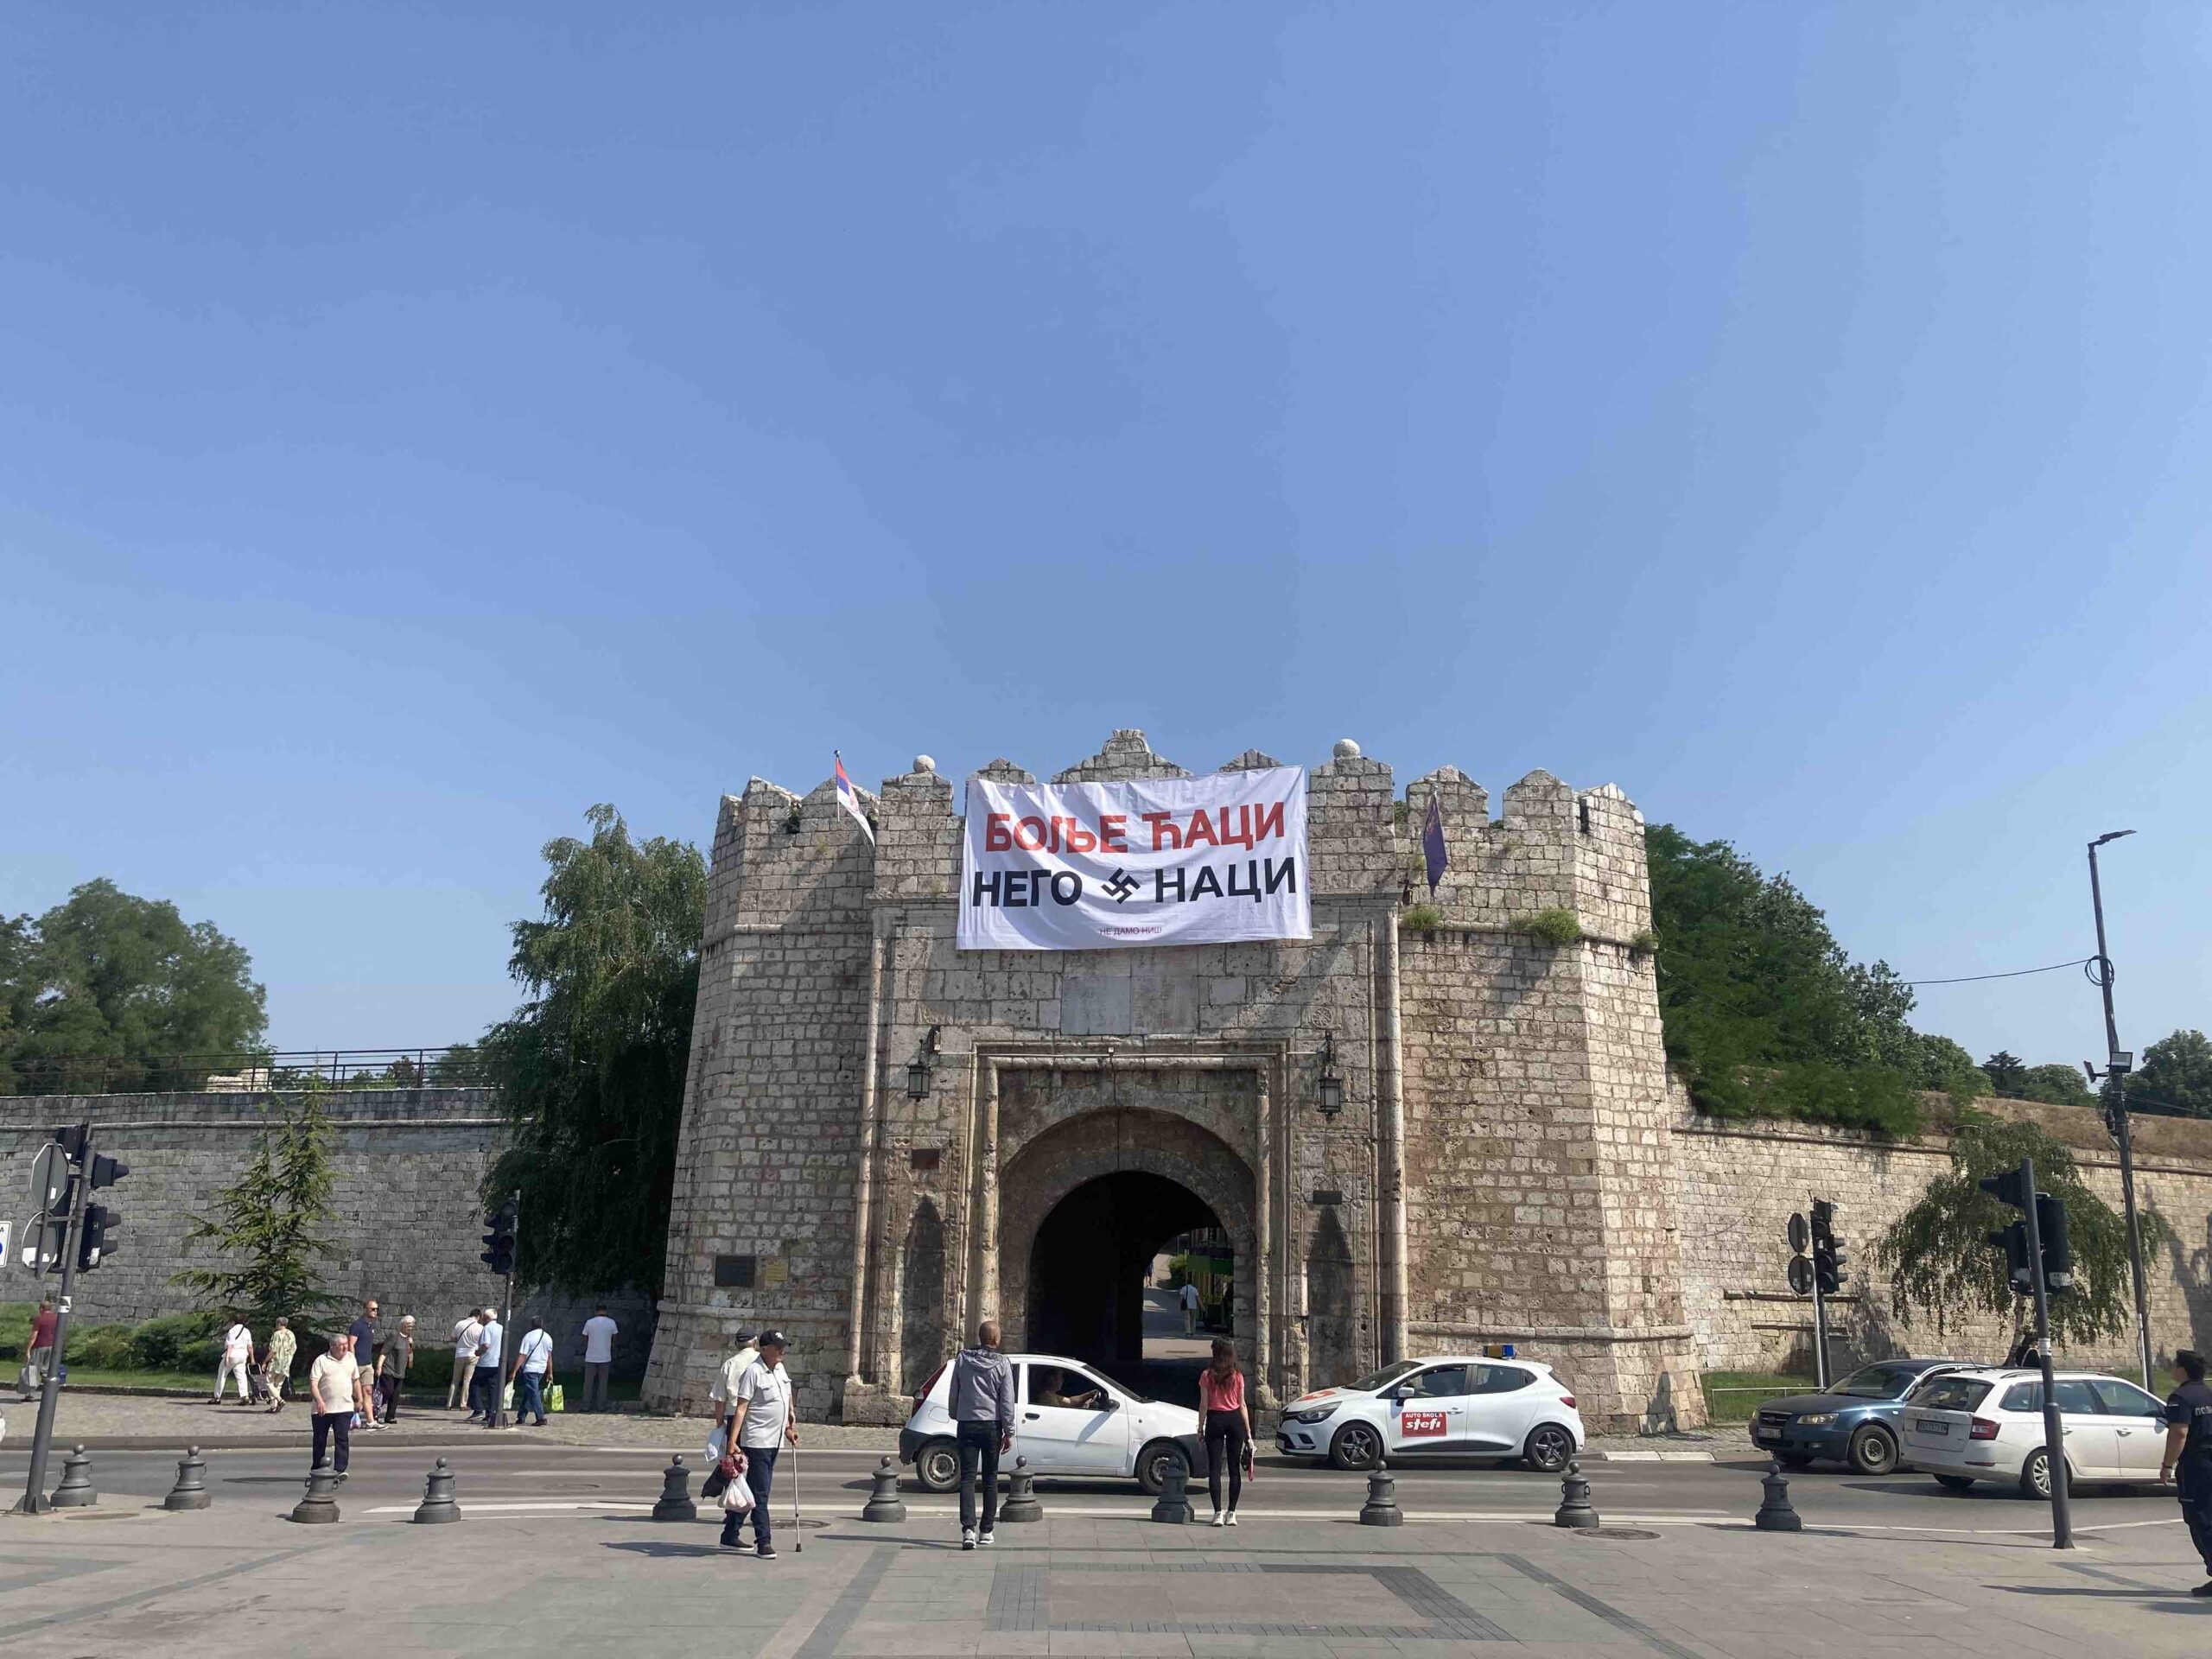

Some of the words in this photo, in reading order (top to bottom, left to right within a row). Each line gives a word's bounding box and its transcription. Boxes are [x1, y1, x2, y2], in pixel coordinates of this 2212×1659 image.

[986, 814, 1128, 854] БОЉЕ
[1142, 802, 1285, 850] ЋАЦИ
[973, 869, 1082, 906] НЕГО
[1156, 857, 1296, 902] НАЦИ
[1099, 927, 1112, 936] НЕ
[1113, 927, 1140, 936] ДАМО
[1406, 1418, 1441, 1431] stefi
